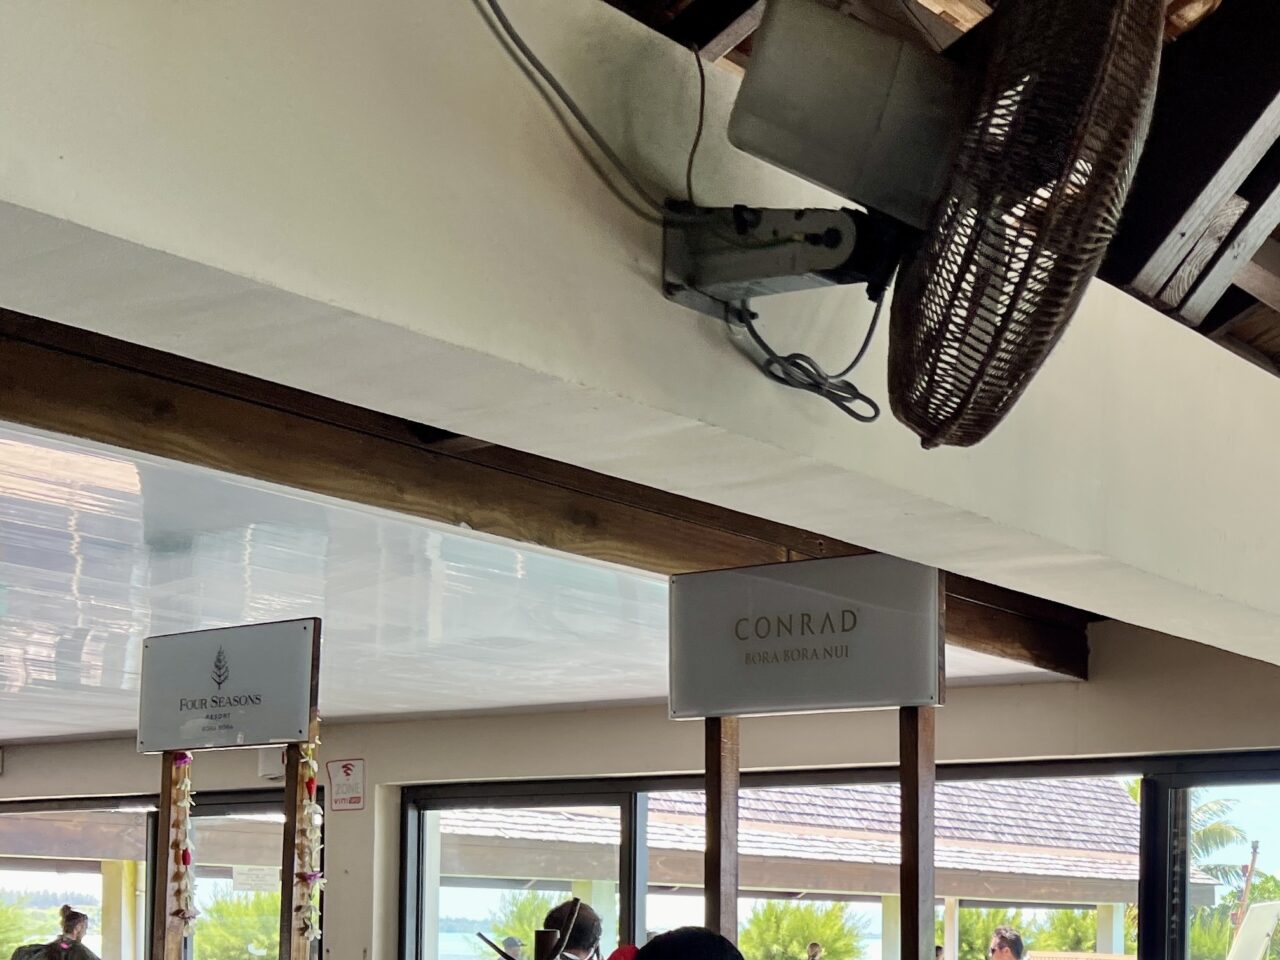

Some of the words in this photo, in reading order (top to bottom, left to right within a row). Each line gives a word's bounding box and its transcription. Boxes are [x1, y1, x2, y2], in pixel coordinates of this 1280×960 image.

[735, 609, 857, 641] CONRAD
[745, 651, 779, 665] BORA
[783, 648, 819, 662] BORA
[823, 645, 849, 660] NUI
[179, 698, 208, 711] FOUR
[210, 694, 262, 709] SEASONS
